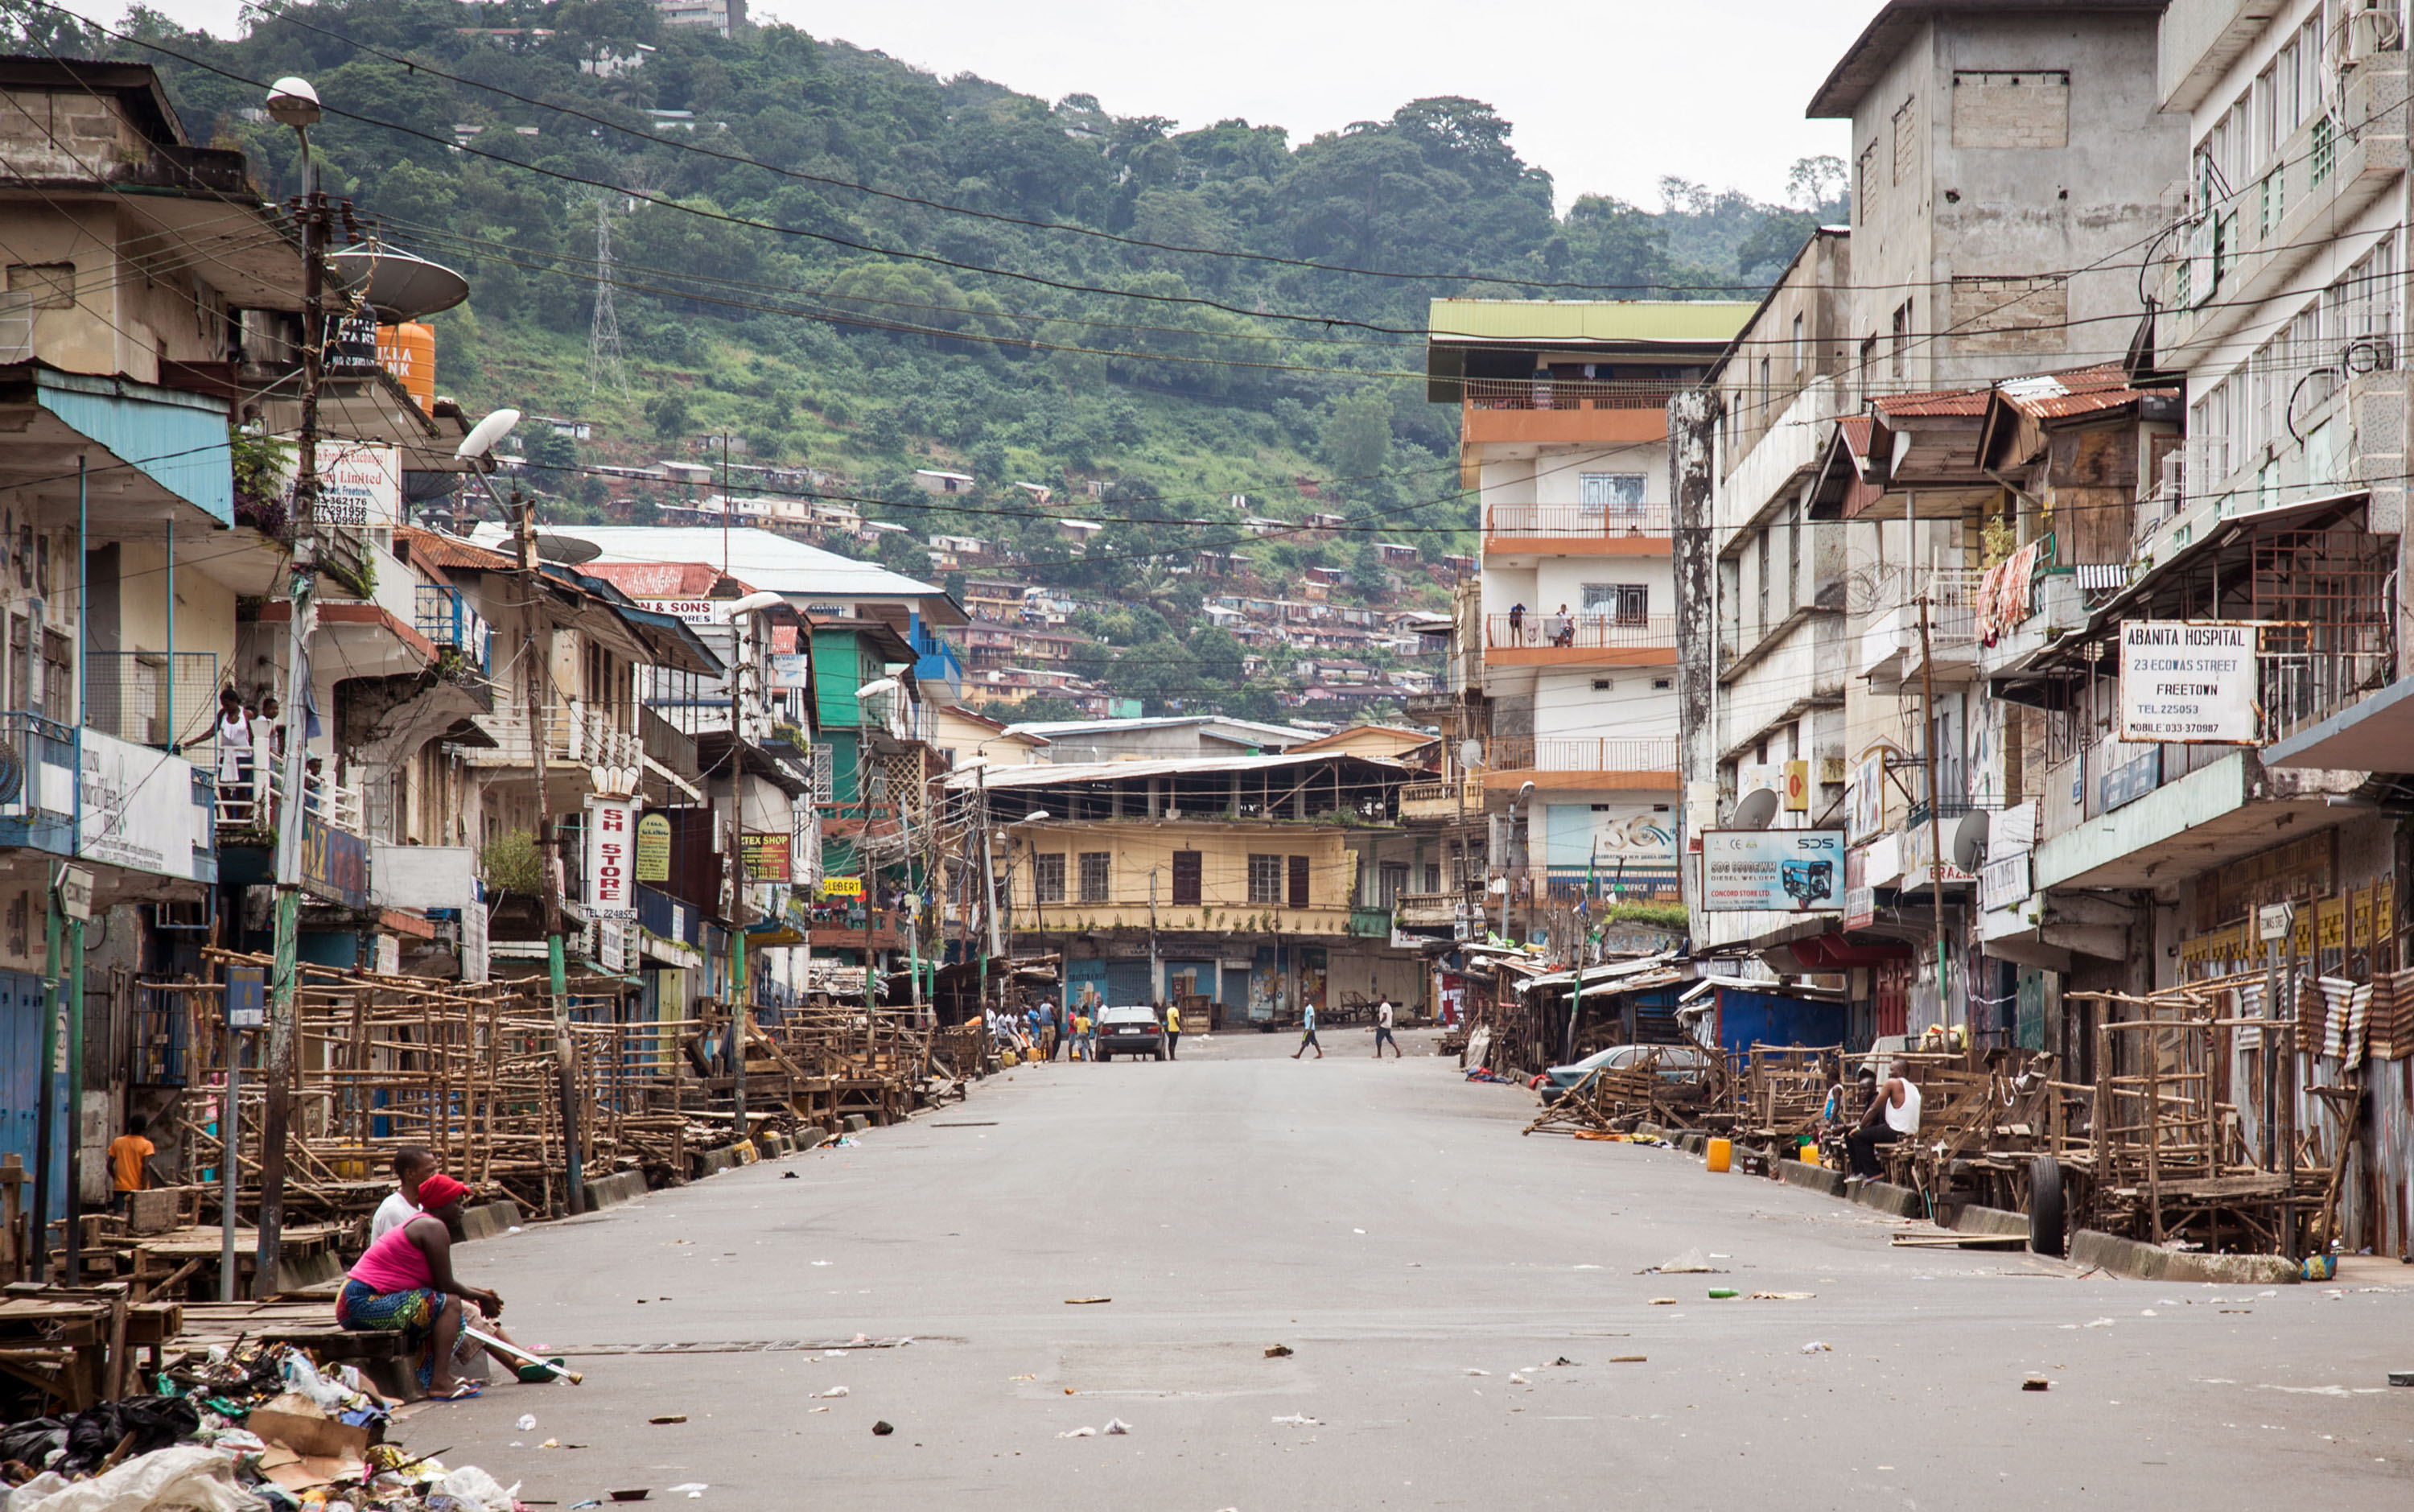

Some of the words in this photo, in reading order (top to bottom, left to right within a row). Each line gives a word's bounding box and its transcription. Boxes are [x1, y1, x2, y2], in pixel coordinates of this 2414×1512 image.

[340, 471, 381, 484] Limited
[656, 603, 664, 612] &
[670, 603, 711, 612] SONS
[2128, 629, 2178, 645] ABANITA
[2185, 629, 2245, 646] HOSPITAL
[2134, 659, 2148, 670] 23
[2151, 660, 2193, 671] ECOWAS
[2197, 660, 2238, 671] STREET
[2157, 684, 2218, 695] FREETOWN
[763, 836, 788, 845] SHOP
[1798, 838, 1834, 849] SDS
[599, 843, 621, 900] STORE
[604, 909, 633, 920] 224855
